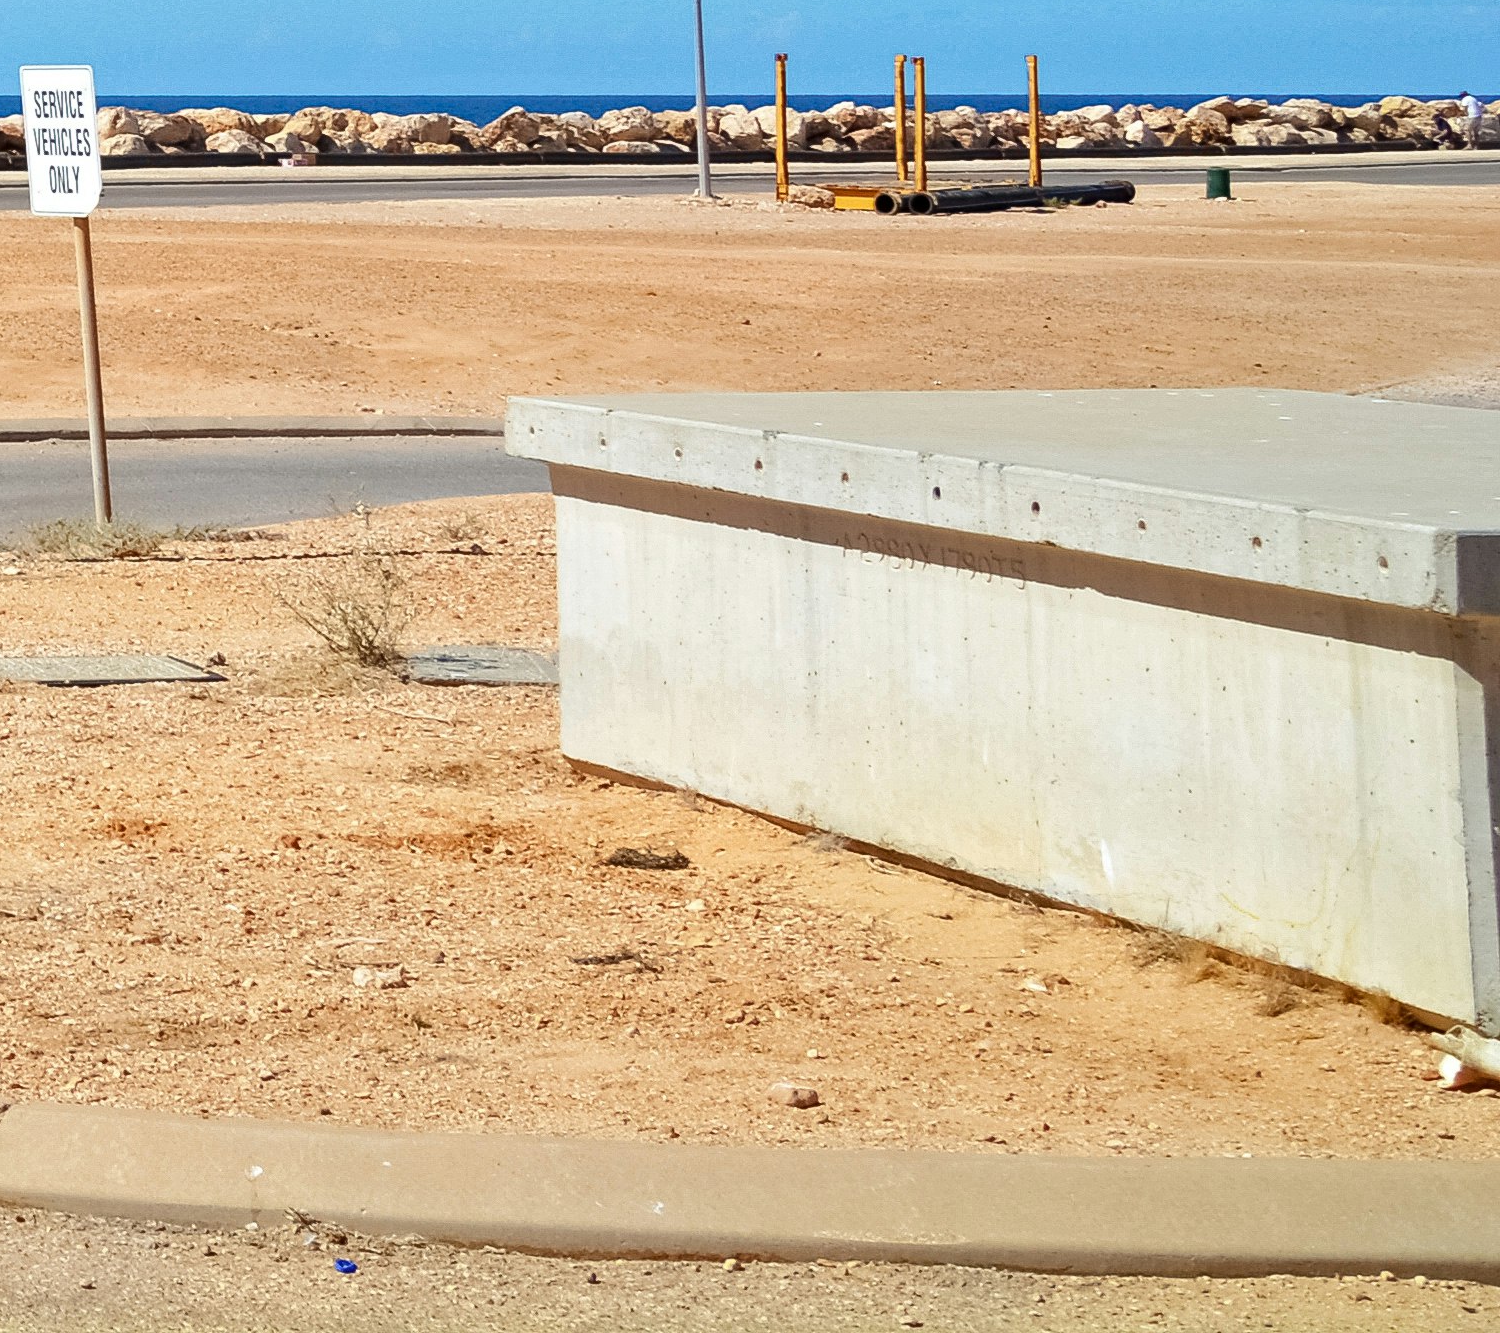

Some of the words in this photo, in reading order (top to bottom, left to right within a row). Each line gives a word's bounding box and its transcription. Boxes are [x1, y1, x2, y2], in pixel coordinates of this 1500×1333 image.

[34, 90, 85, 119] SERVICE
[33, 128, 91, 157] VEHICLES
[49, 165, 80, 194] ONLY
